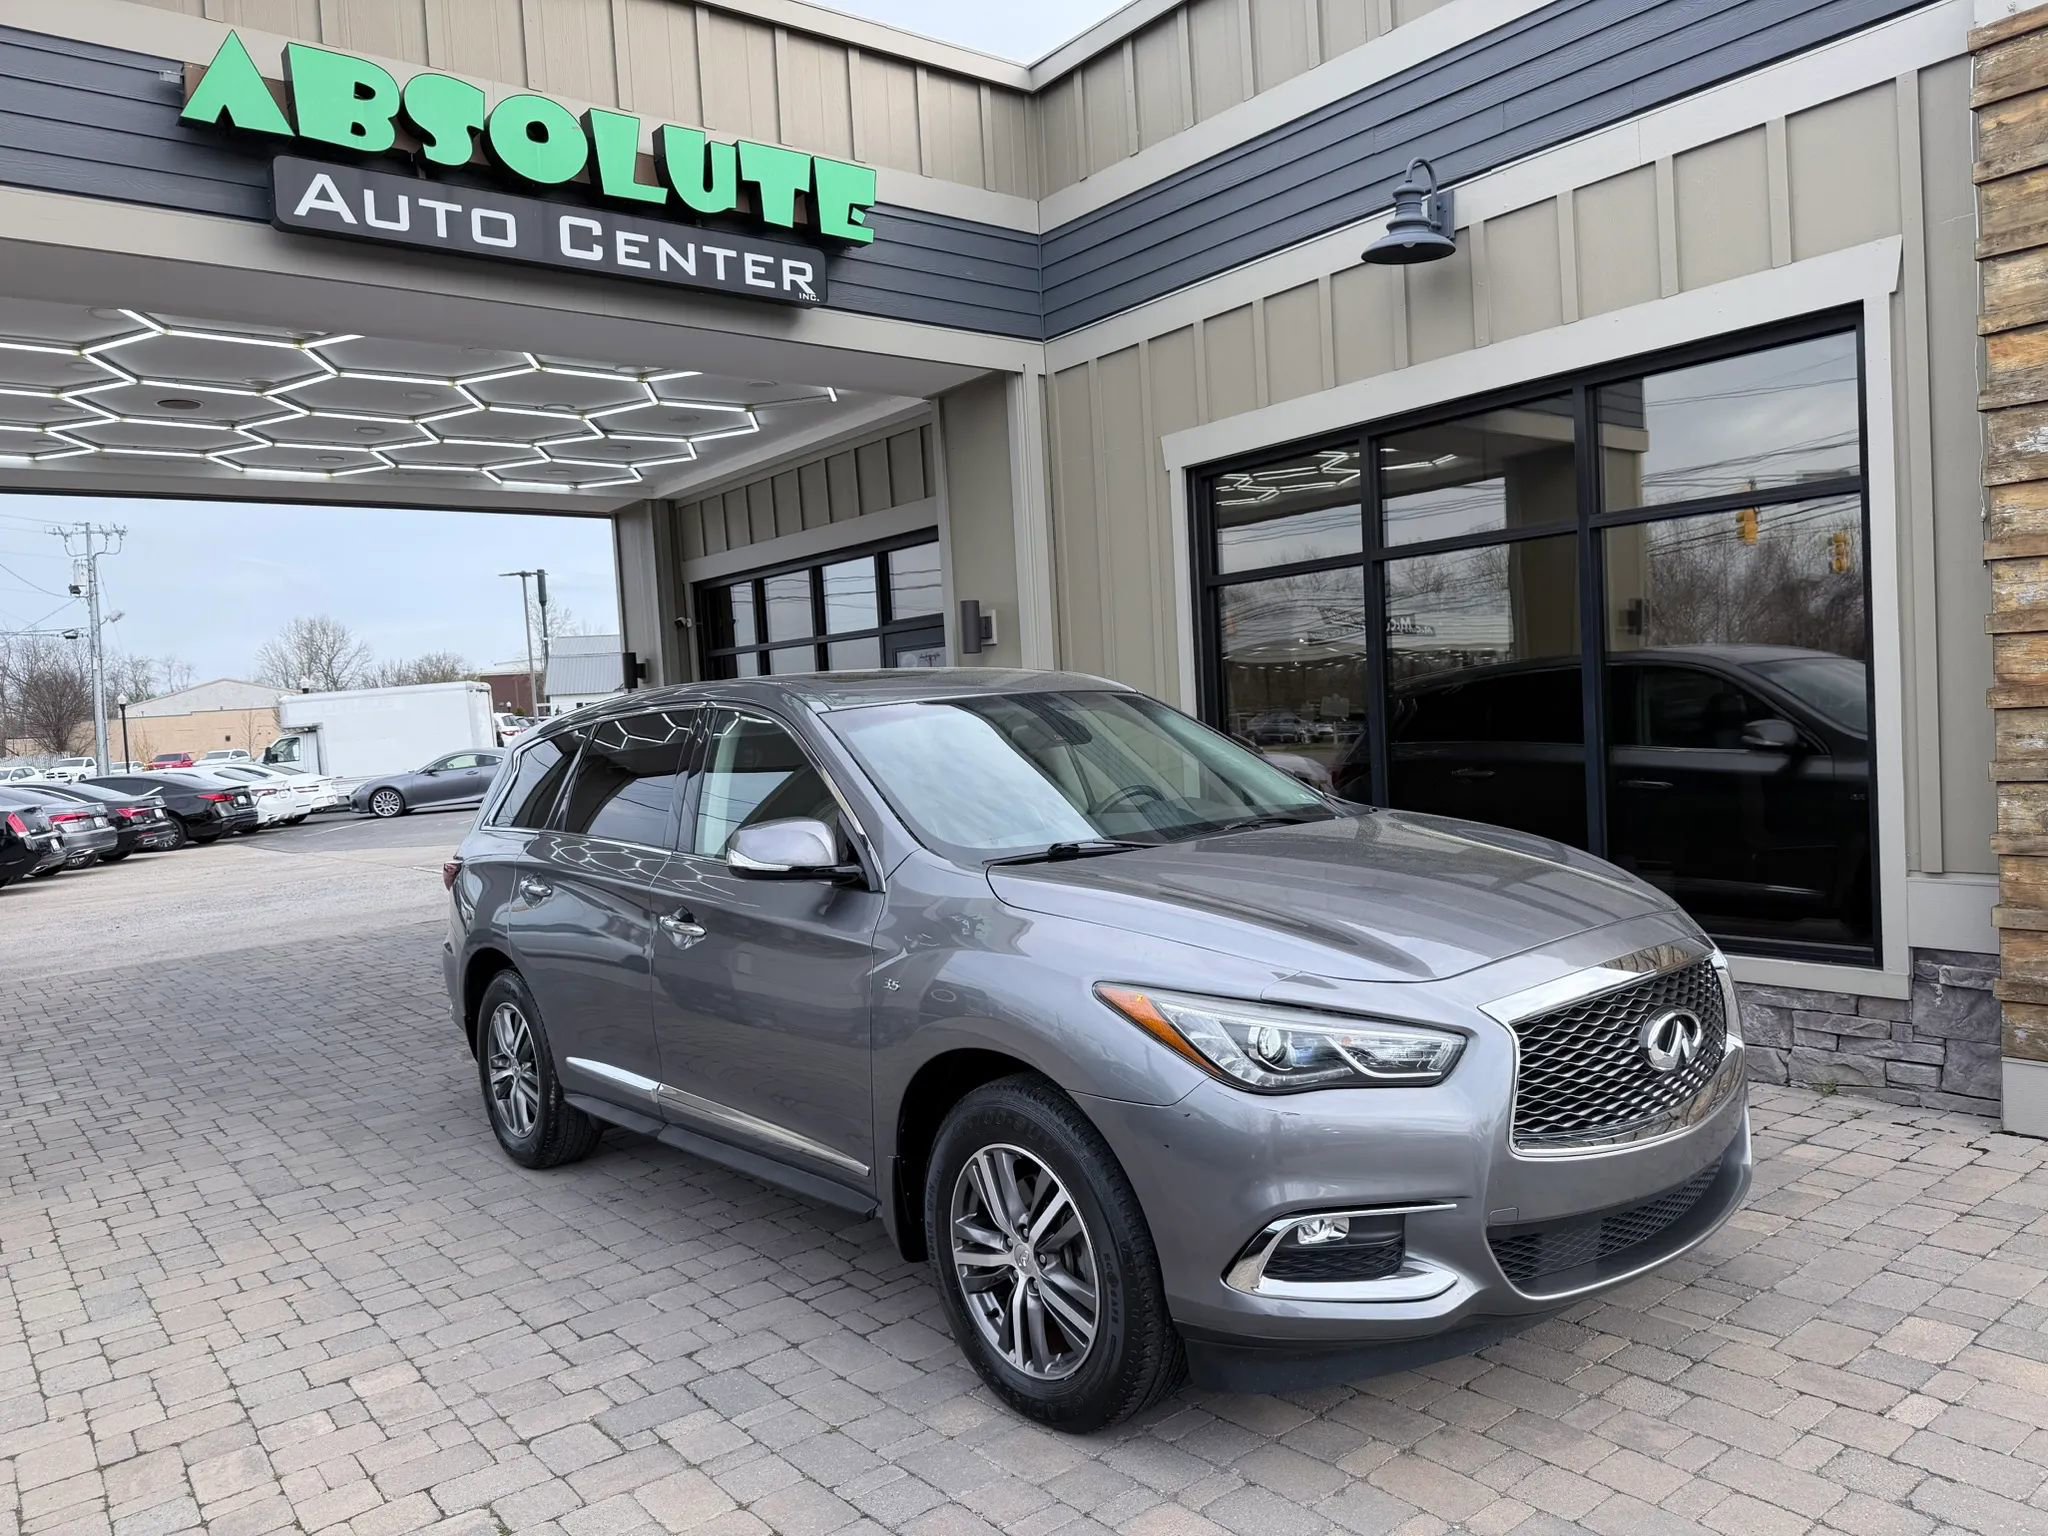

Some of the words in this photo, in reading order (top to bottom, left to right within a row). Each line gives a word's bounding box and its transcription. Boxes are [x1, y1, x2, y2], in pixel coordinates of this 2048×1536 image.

[180, 29, 876, 244] ABSOLUTE
[294, 173, 517, 248] AUTO
[559, 215, 816, 295] CENTER
